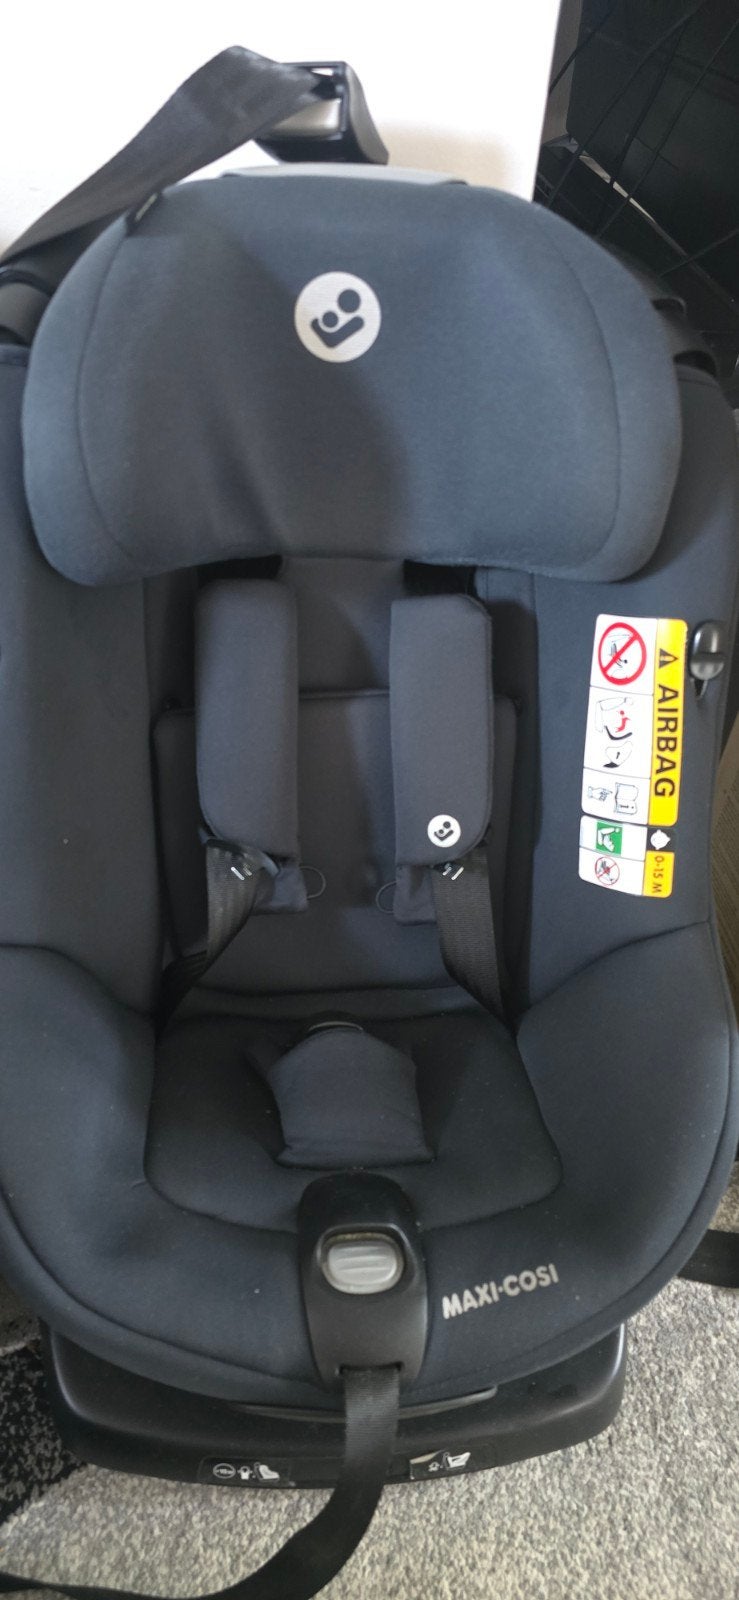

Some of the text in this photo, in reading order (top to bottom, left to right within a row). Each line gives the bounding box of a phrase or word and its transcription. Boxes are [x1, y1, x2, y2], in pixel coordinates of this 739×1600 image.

[655, 684, 679, 797] AIRBAG
[652, 856, 664, 894] 0-15 M
